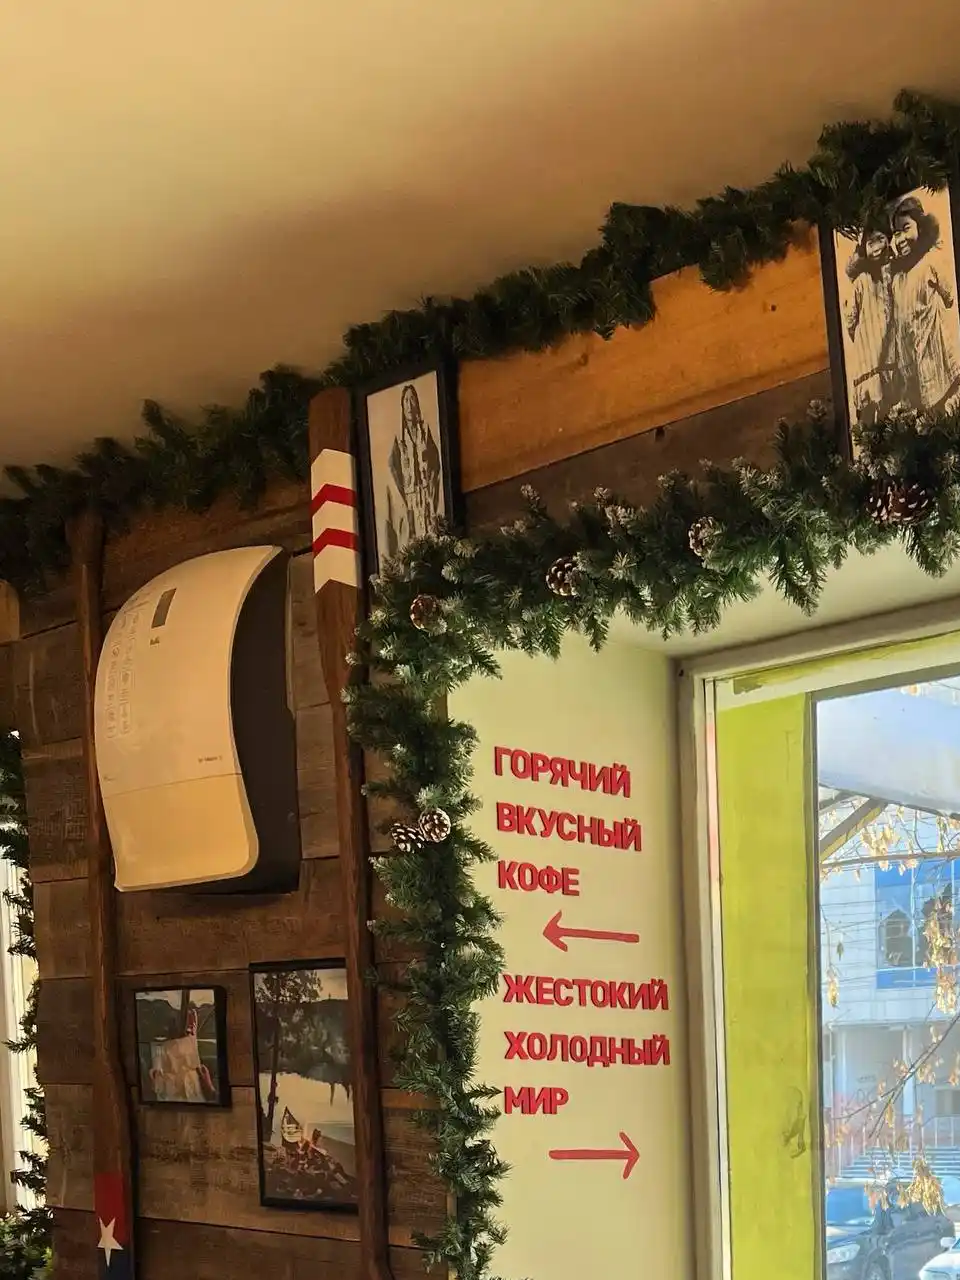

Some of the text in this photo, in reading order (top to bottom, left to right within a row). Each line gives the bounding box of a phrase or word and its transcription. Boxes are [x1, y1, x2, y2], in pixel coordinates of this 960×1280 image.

[494, 746, 632, 798] ГОРЯЧИЙ
[496, 801, 643, 852] ВКУСНЫЙ
[497, 860, 580, 896] КОФЕ
[503, 975, 669, 1010] ЖЕСТОКИЙ
[504, 1031, 671, 1068] ХОЛОДНЫЙ
[504, 1086, 569, 1115] МИР
